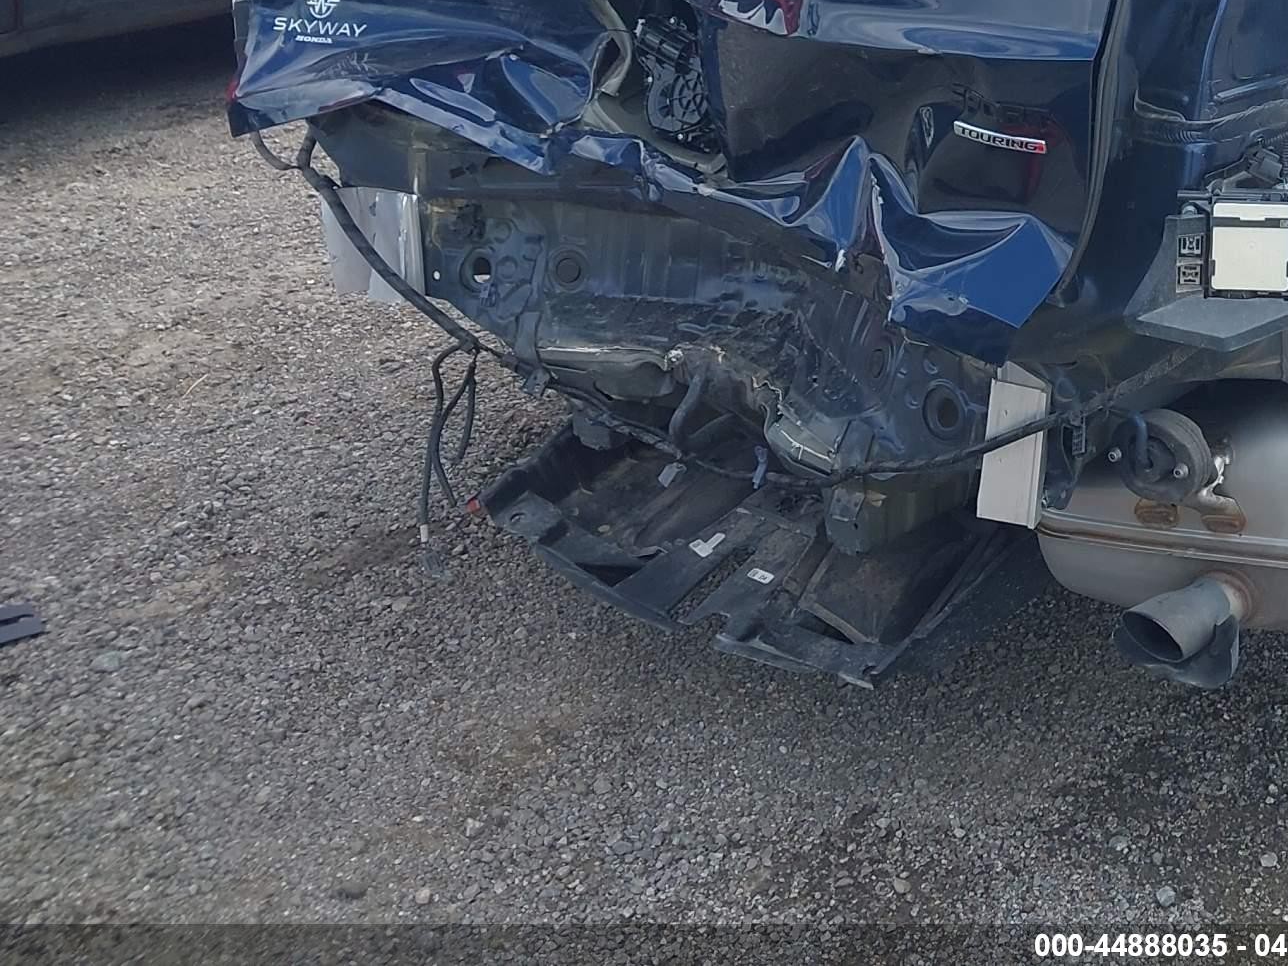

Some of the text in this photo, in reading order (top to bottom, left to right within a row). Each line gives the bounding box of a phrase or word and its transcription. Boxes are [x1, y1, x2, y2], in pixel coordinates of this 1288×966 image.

[272, 17, 367, 38] SKYWAY
[295, 35, 333, 44] HONDA
[956, 124, 1038, 152] TOURING
